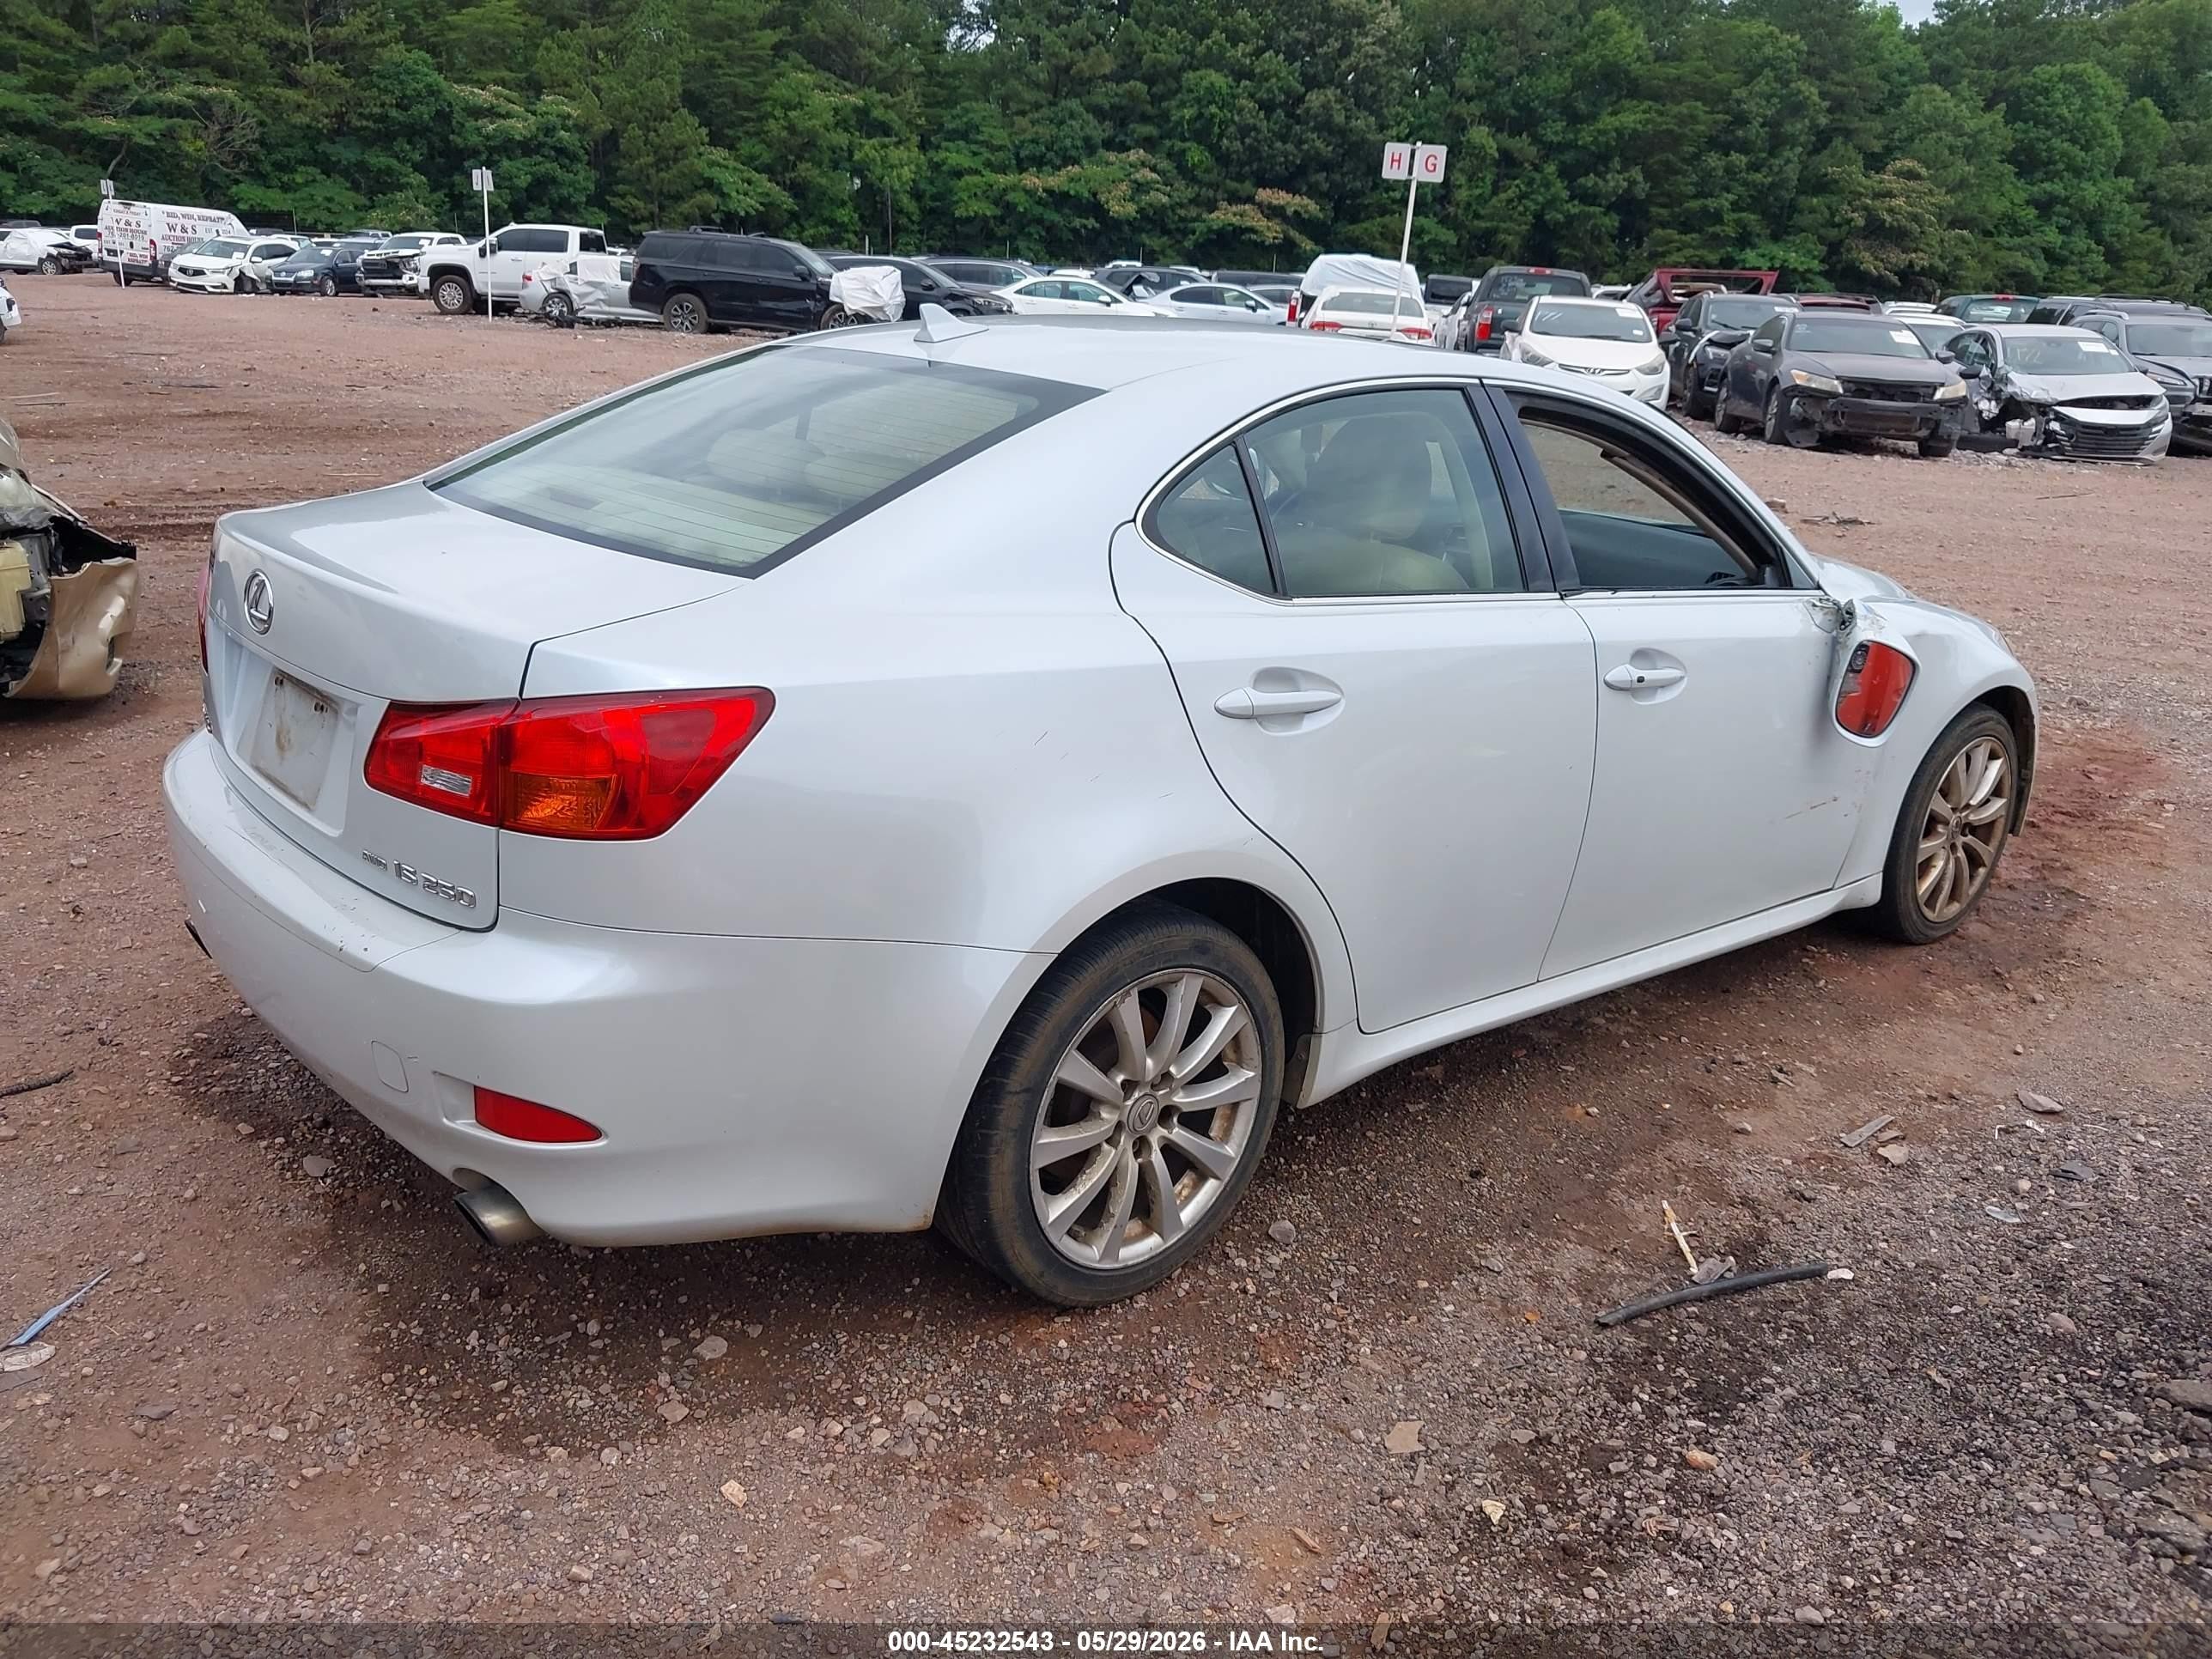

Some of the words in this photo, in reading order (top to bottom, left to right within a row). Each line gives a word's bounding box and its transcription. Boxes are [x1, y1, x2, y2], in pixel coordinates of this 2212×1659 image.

[1390, 152, 1402, 171] H
[1425, 154, 1438, 173] G
[124, 218, 132, 228] &
[135, 220, 142, 228] S
[166, 223, 178, 234] W
[180, 223, 189, 234] &
[191, 224, 198, 234] S
[393, 860, 418, 885] IS
[420, 872, 477, 908] 250
